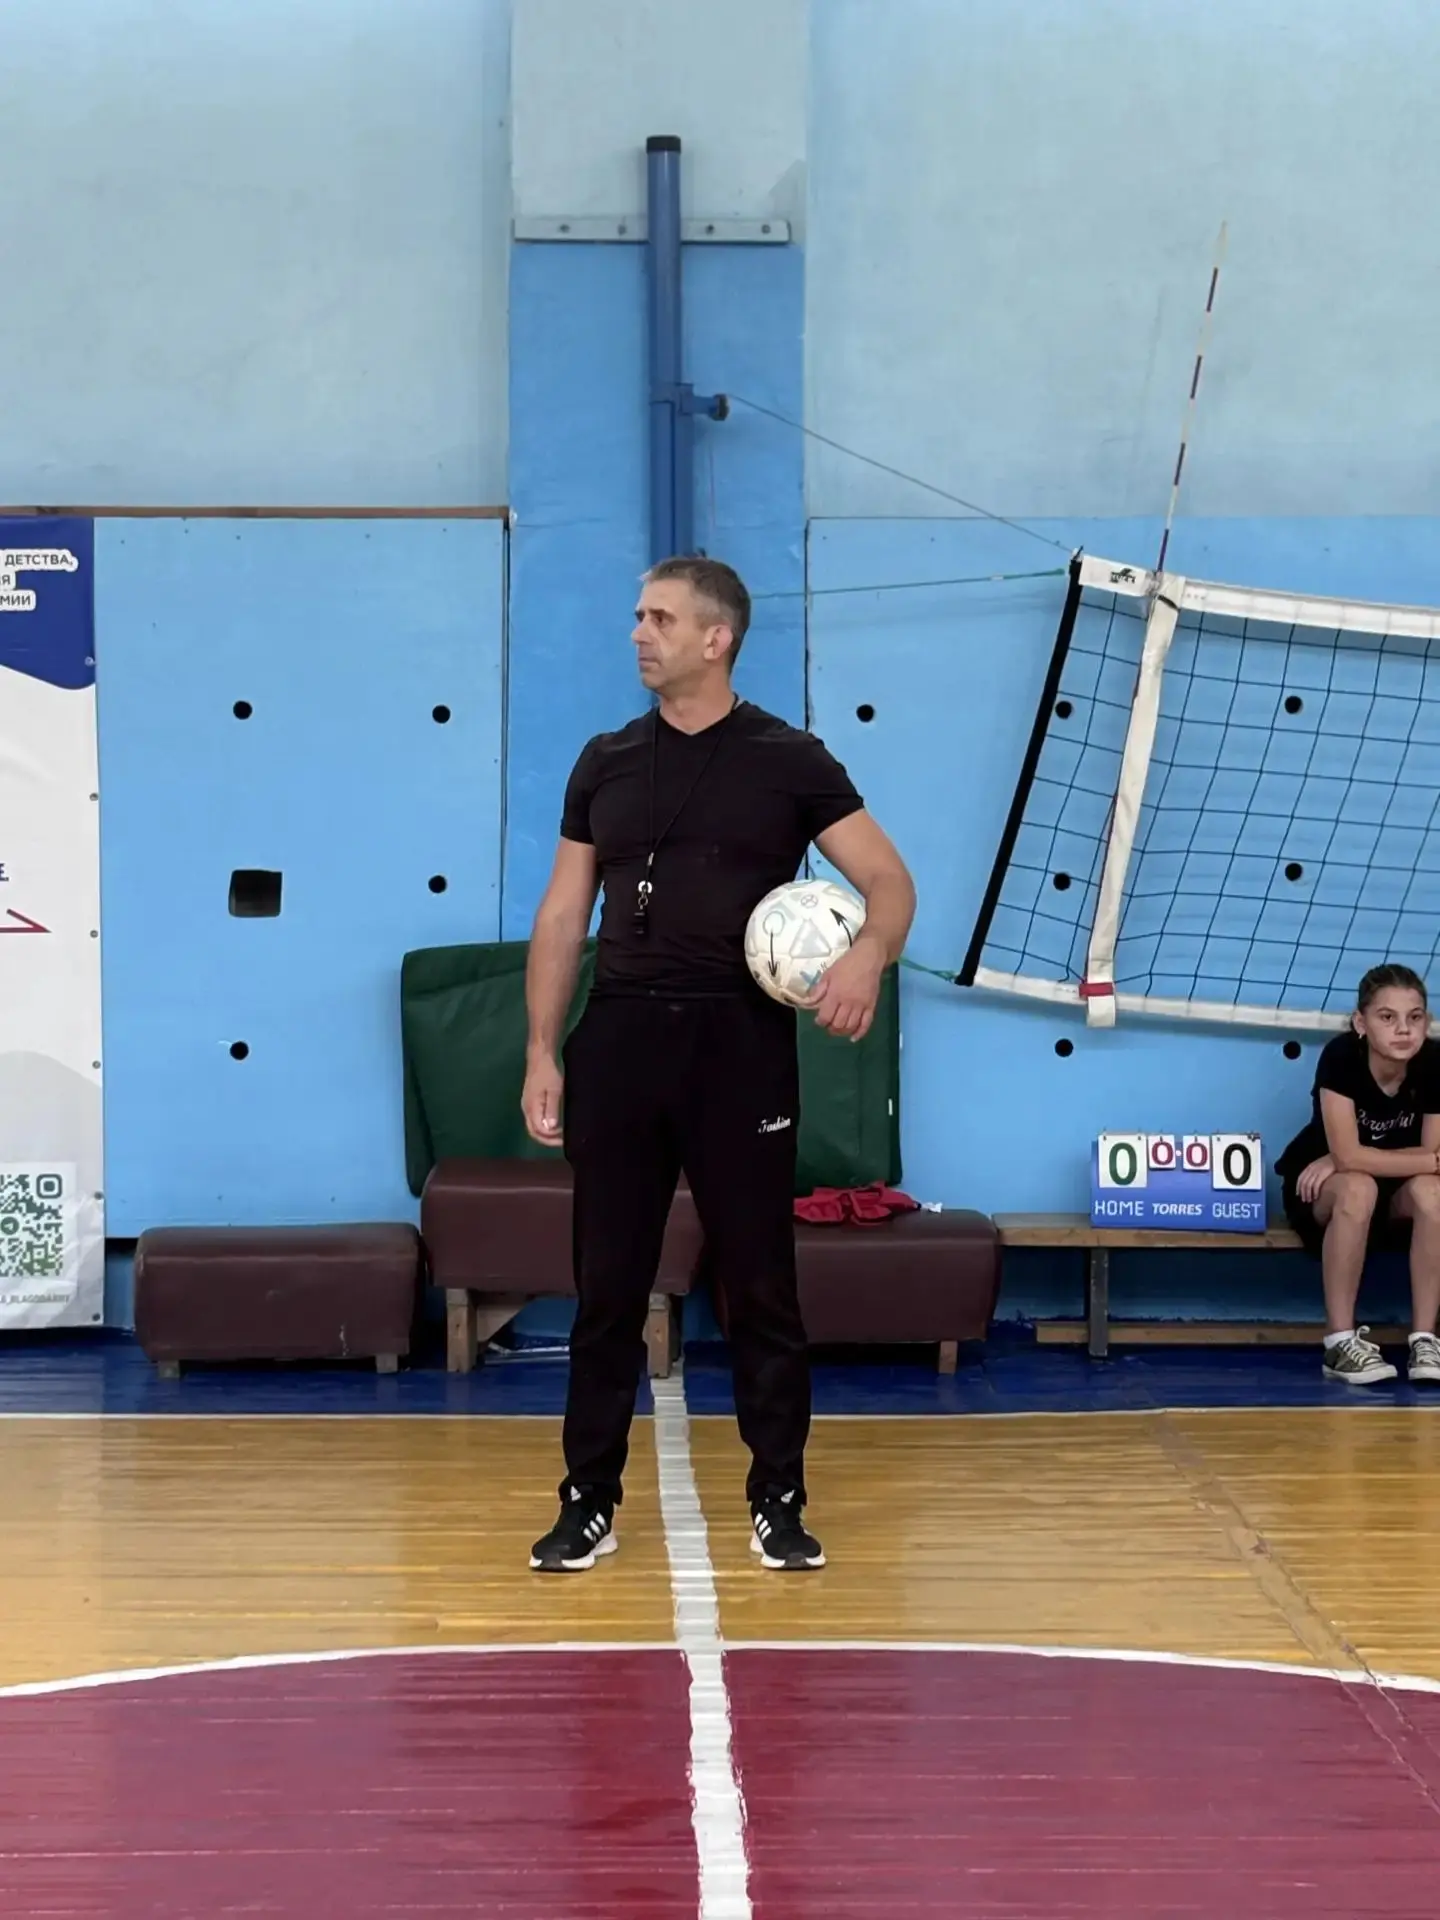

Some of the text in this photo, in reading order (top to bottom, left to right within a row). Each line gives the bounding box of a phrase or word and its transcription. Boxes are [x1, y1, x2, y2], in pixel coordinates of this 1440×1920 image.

[5, 553, 73, 567] ДЕТСТВА,
[1108, 1141, 1252, 1187] 0 0 0 0
[1094, 1200, 1262, 1219] HOME TORRES GUEST
